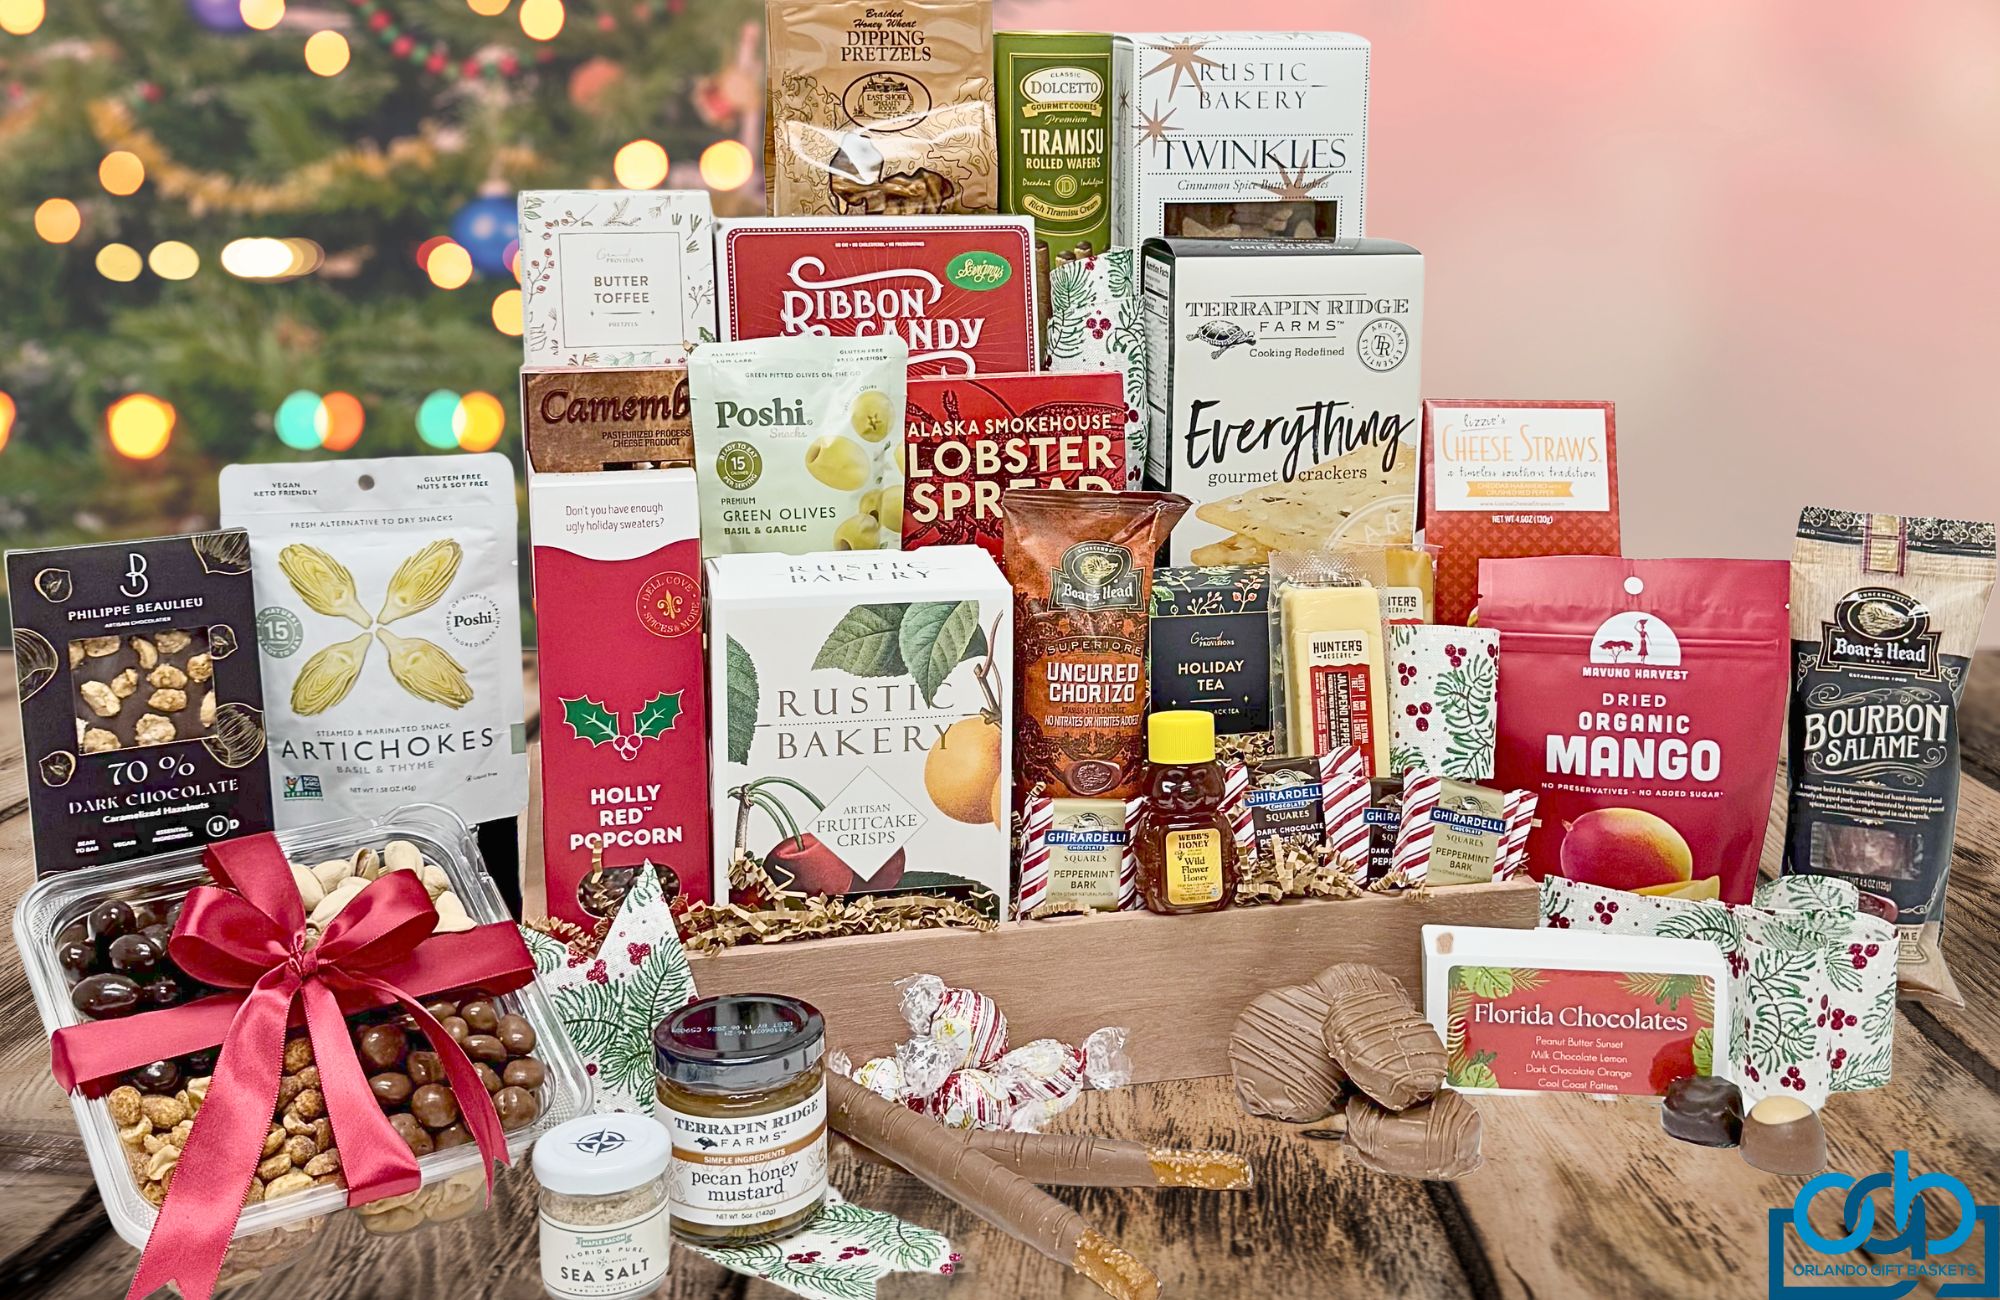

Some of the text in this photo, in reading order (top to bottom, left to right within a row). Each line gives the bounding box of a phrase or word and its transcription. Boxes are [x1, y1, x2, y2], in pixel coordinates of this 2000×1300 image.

[865, 9, 903, 18] Braided
[853, 19, 917, 28] Honey Wheat
[847, 31, 924, 46] DIPPING
[841, 47, 931, 62] PRETZELS
[1200, 63, 1308, 81] RUSTIC
[1031, 81, 1098, 94] DOLCETTO
[1200, 90, 1307, 109] BAKERY
[1044, 114, 1088, 125] Premium
[1021, 128, 1104, 155] TIRAMISU
[1158, 139, 1346, 170] TWINKLES
[1026, 157, 1101, 169] ROLLED WAFERS
[1177, 180, 1329, 193] Cinnamon Spice Butter Cookies
[594, 275, 649, 287] BUTTER
[594, 293, 649, 303] TOFFEE
[780, 288, 926, 337] RIBBON
[1186, 299, 1409, 317] TERRAPIN RIDGE
[1250, 347, 1344, 359] Cooking Redefined
[602, 429, 691, 439] PASTEURIZED PROCESS
[908, 419, 980, 437] ALASKA
[613, 438, 680, 448] CHEESE PRODUCT
[1185, 400, 1415, 483] Everything
[731, 457, 745, 470] 15
[909, 435, 1116, 478] LOBSTER
[1208, 467, 1367, 487] gourmet crackers
[721, 497, 755, 505] PREMIUM
[565, 502, 663, 518] Don't you have enough
[723, 507, 836, 522] GREEN OLIVES
[320, 518, 378, 527] ALTERNATIVE
[566, 517, 664, 533] ugly holiday sweaters?
[724, 527, 750, 535] BASIL
[766, 525, 807, 533] GARLIC
[642, 577, 693, 601] DELL COVE
[1062, 579, 1133, 601] Boar's Head
[68, 598, 203, 621] PHILIPPE BEAULIEU
[454, 612, 492, 628] Poshi
[1047, 641, 1142, 656] SUPERIORE
[1313, 640, 1362, 653] HUNTER'S
[1833, 637, 1926, 662] Boar's Head
[1047, 662, 1139, 683] UNCURED
[1178, 660, 1244, 675] HOLIDAY
[1582, 667, 1688, 680] MAVUNO HARVEST
[1198, 679, 1224, 691] TEA
[778, 683, 954, 717] RUSTIC
[1049, 683, 1135, 703] CHORIZO
[1602, 693, 1666, 707] DRIED
[1579, 712, 1689, 733] ORGANIC
[1804, 704, 1949, 751] BOURBON
[282, 728, 494, 762] ARTICHOKES
[778, 723, 952, 759] BAKERY
[1546, 734, 1720, 781] MANGO
[1826, 736, 1920, 766] SALAME
[108, 754, 195, 786] 70 %
[337, 761, 435, 775] BASIL & THYME
[68, 779, 239, 814] DARK CHOCOLATE
[591, 784, 661, 805] HOLLY
[102, 801, 209, 824] Caramelized Hazelnuts
[843, 804, 890, 814] ARTISAN
[1266, 810, 1310, 821] SQUARES
[816, 814, 917, 833] FRUITCAKE
[1433, 809, 1504, 832] GHIRARDELLI
[1178, 833, 1209, 841] WEBB'S
[1256, 823, 1324, 836] DARK CHOCOLATE
[570, 826, 682, 851] POPCORN
[836, 831, 895, 847] CRISPS
[1048, 833, 1126, 842] GHIRARDELLI
[1179, 840, 1209, 848] HONEY
[1446, 834, 1483, 847] SQUARES
[1185, 857, 1205, 865] Wild
[1436, 847, 1490, 864] PEPPERMINT
[1449, 861, 1472, 871] BARK
[1054, 870, 1114, 878] PEPPERMINT
[1071, 880, 1096, 889] BARK
[1474, 1003, 1687, 1032] Florida Chocolates
[1536, 1036, 1623, 1049] Peanut Butter Sunset
[1531, 1051, 1627, 1064] Milk Chocolate Lemon
[1526, 1064, 1632, 1079] Dark Chocolate Orange
[1538, 1079, 1618, 1091] Cool Coast Patties
[674, 1099, 818, 1135] TERRAPIN RIDGE
[704, 1149, 786, 1164] SIMPLE INGREDIENTS
[692, 1161, 799, 1186] pecan honey
[708, 1180, 784, 1201] mustard
[561, 1258, 650, 1282] SEA SALT
